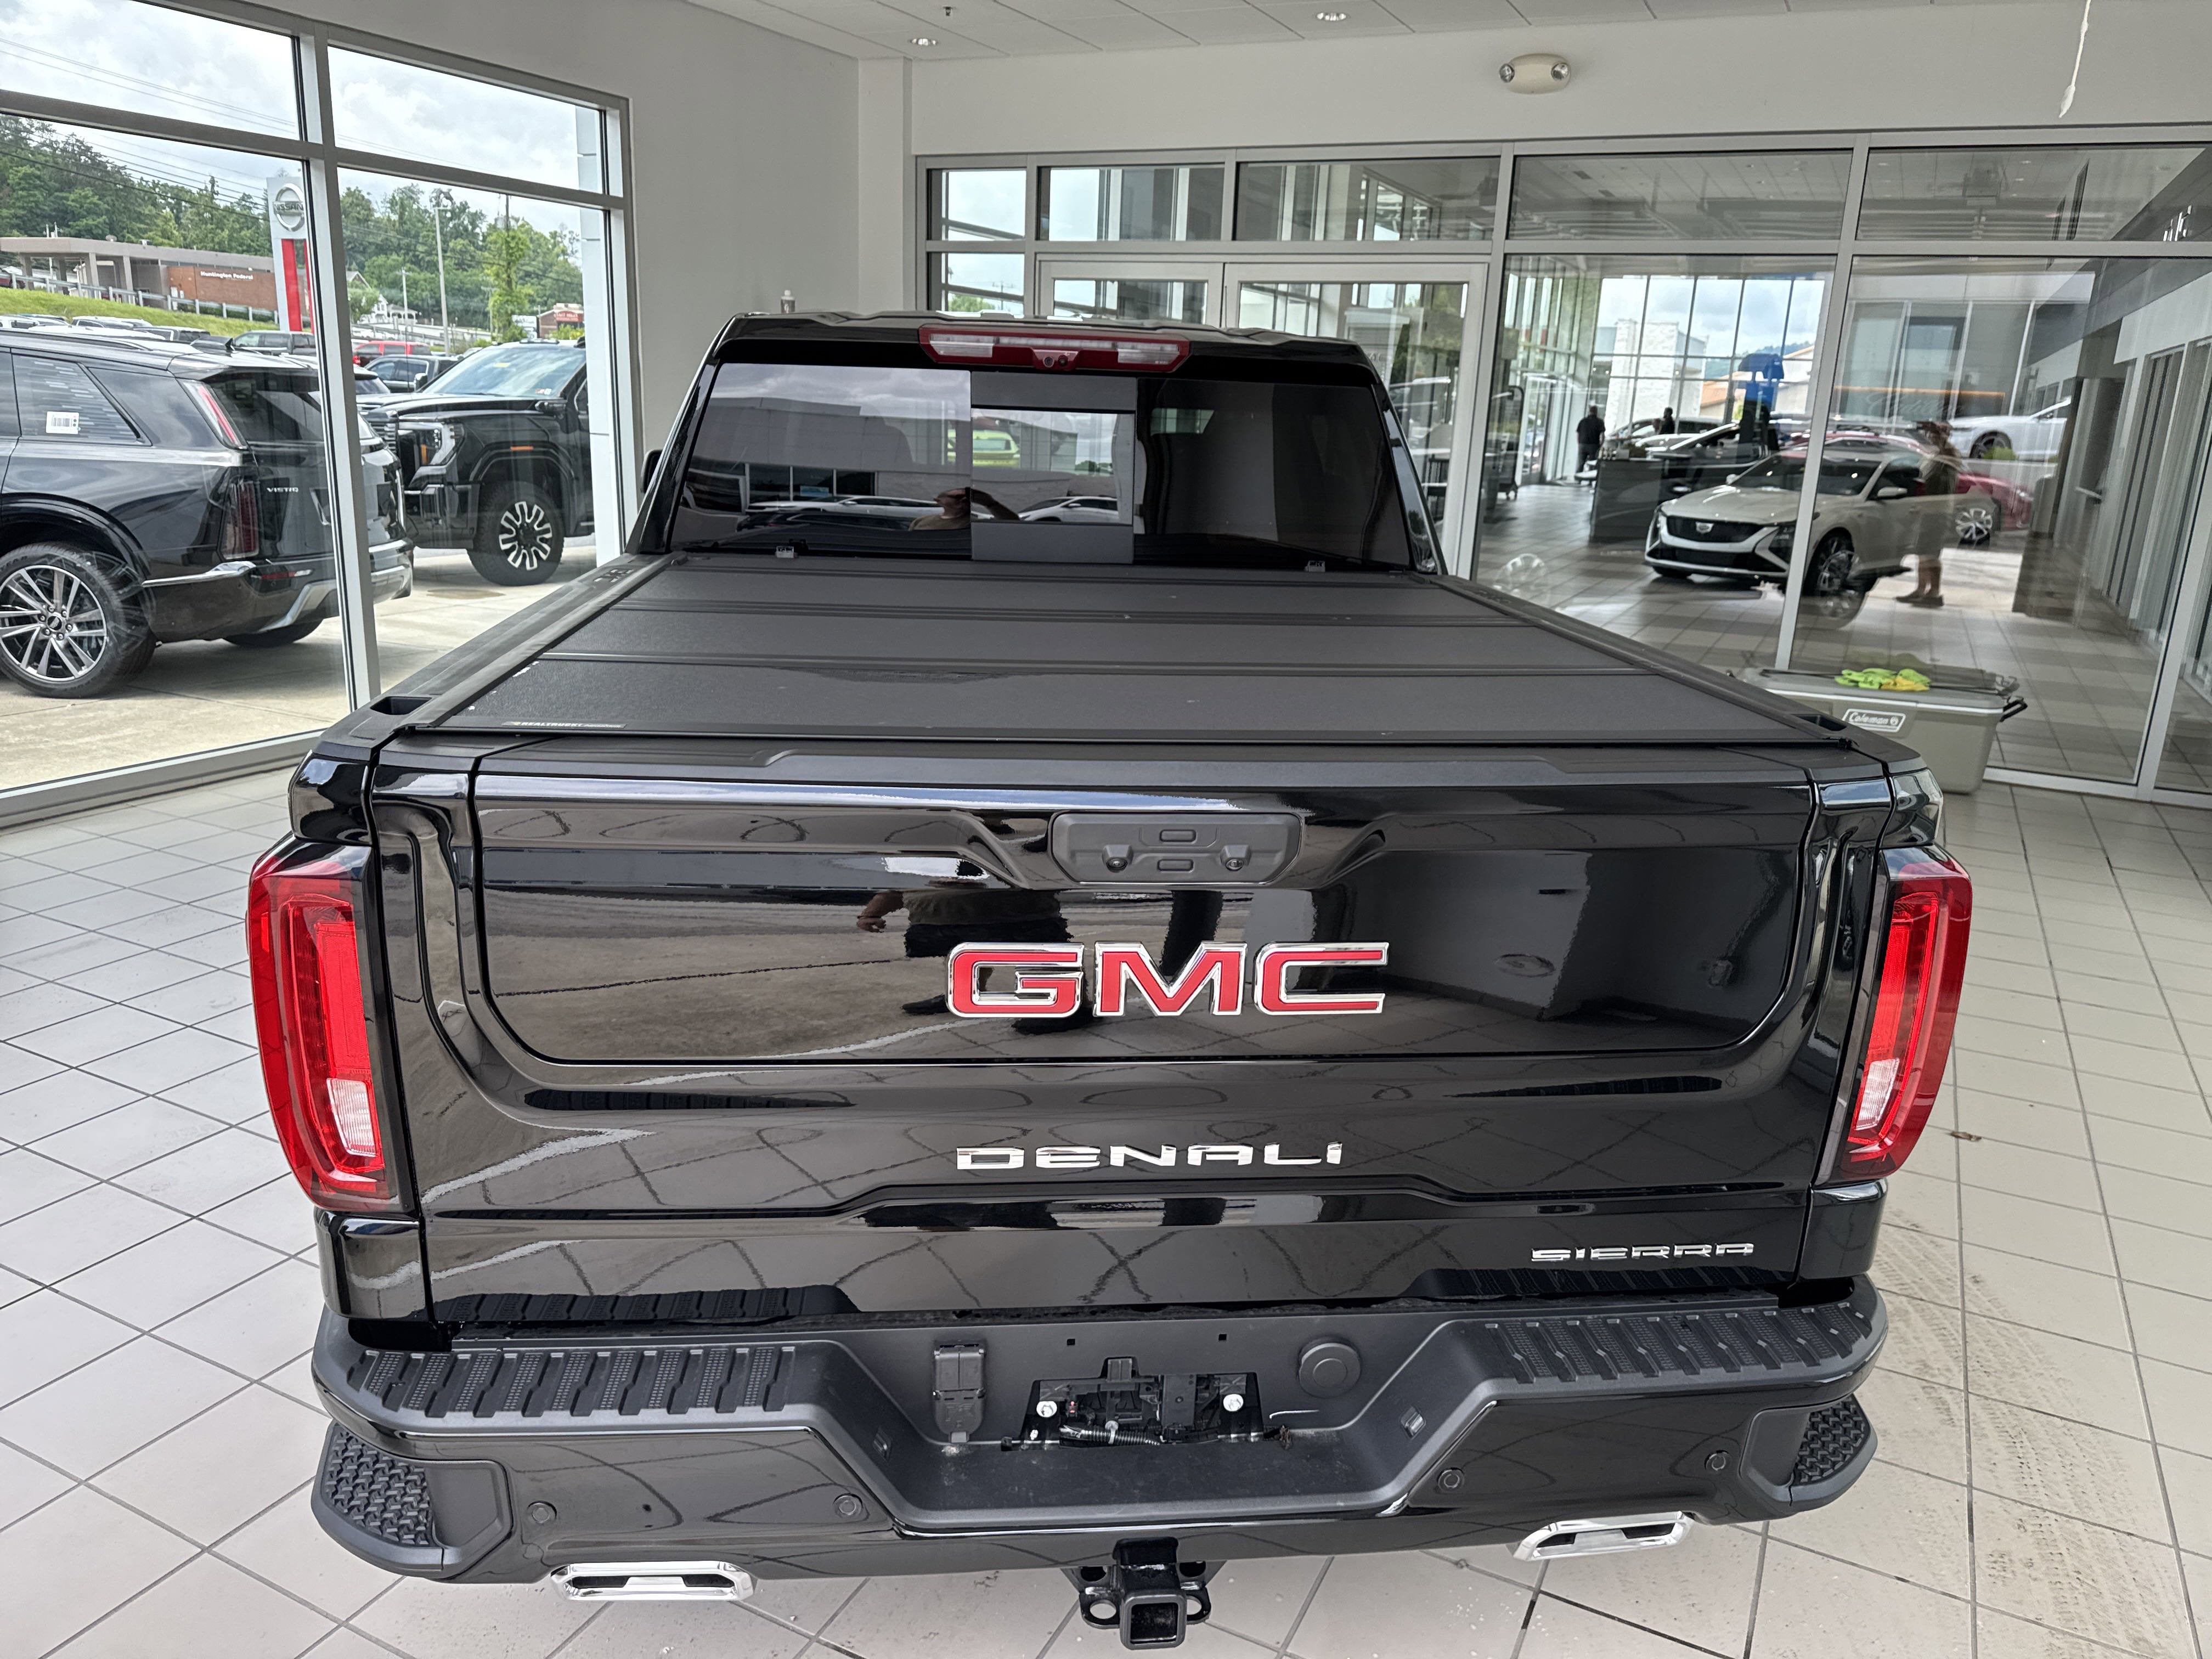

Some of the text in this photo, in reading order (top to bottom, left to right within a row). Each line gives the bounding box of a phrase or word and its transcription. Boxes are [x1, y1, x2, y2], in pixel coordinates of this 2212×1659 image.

[200, 270, 232, 279] Huntington
[1849, 712, 1889, 725] Coleman
[946, 941, 1390, 1018] GMC
[956, 1142, 1342, 1170] DENALI
[1531, 1243, 1754, 1262] SIERRA
